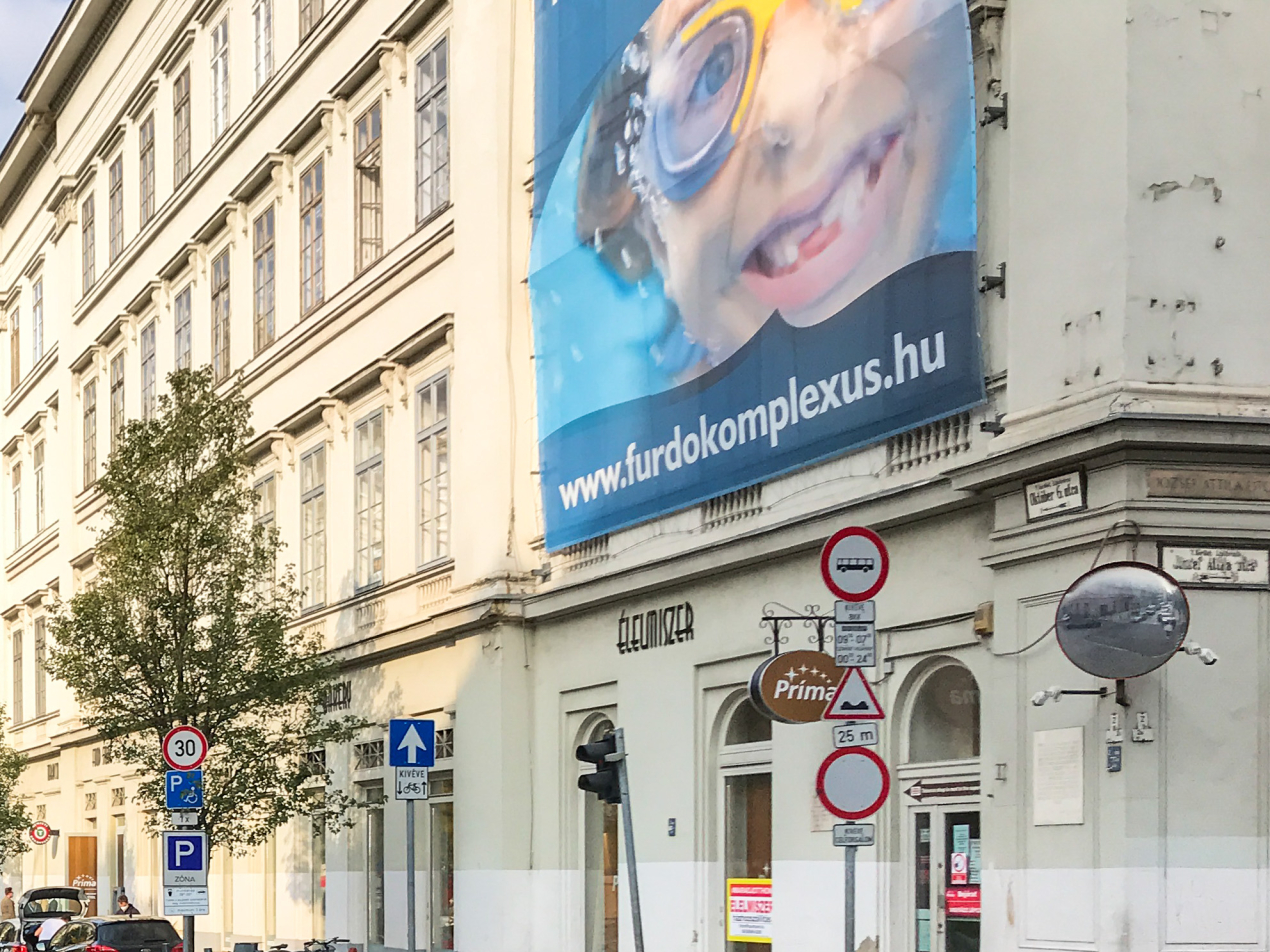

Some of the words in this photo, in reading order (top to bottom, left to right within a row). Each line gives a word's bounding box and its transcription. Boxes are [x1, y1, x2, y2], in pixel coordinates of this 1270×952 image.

[558, 331, 946, 510] www.furdokomplexus.hu
[616, 601, 695, 655] ÉLELMISZER
[773, 677, 837, 702] Príma
[838, 729, 855, 743] 25
[859, 730, 874, 742] m
[174, 739, 196, 757] 30
[399, 768, 425, 778] KIVÉVE
[170, 775, 183, 792] P
[175, 840, 195, 867] P
[174, 875, 196, 883] ZÓNA
